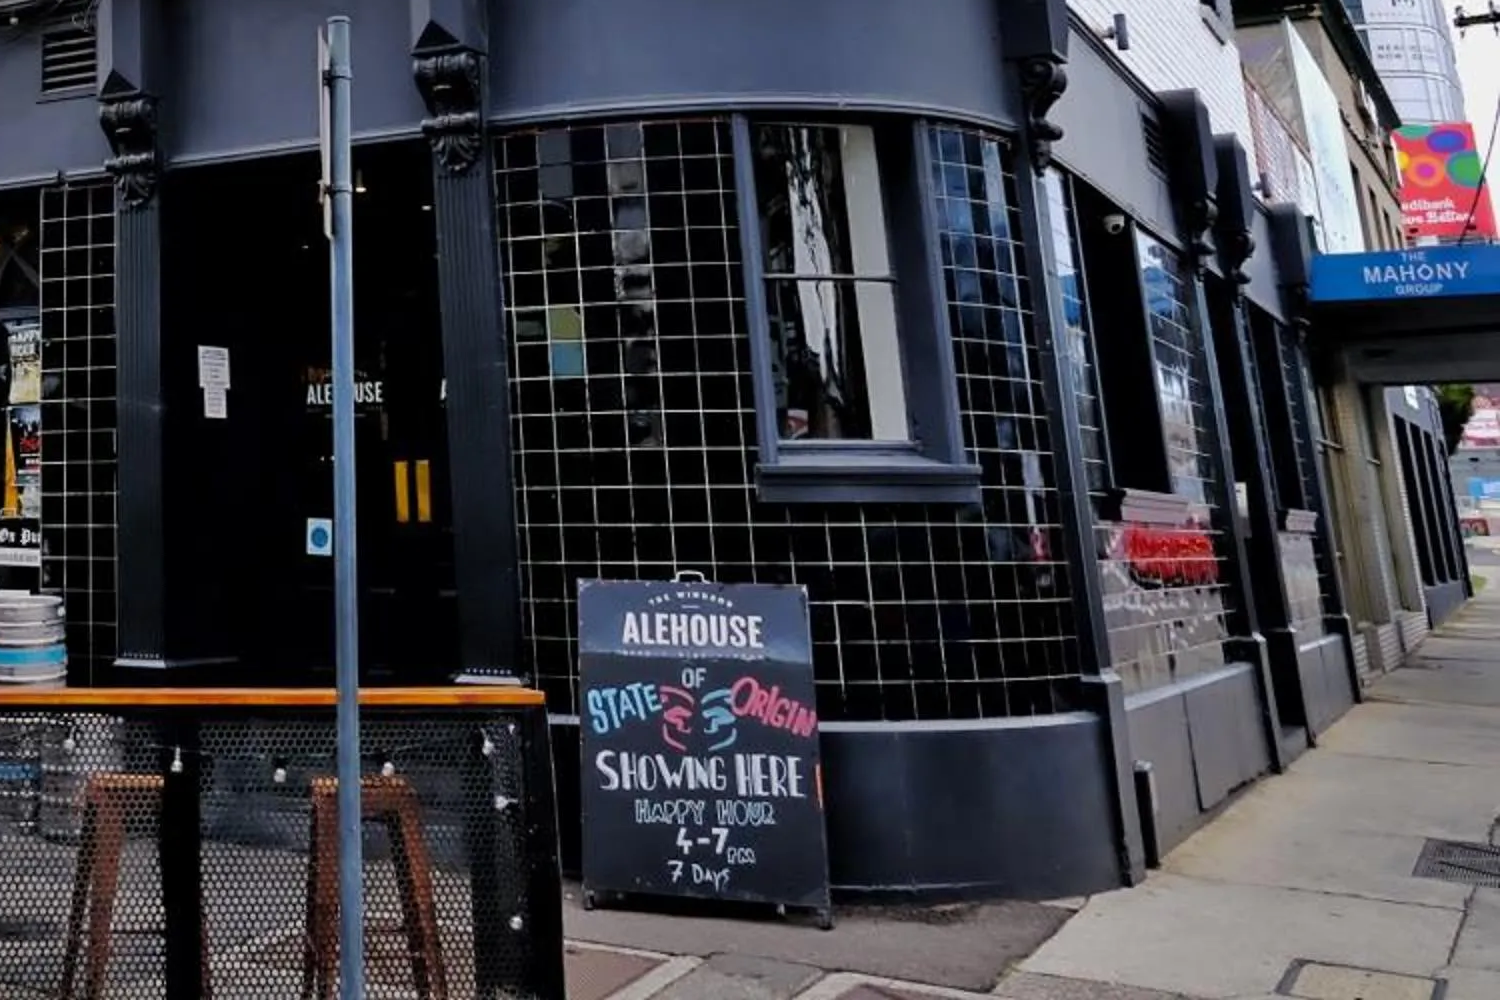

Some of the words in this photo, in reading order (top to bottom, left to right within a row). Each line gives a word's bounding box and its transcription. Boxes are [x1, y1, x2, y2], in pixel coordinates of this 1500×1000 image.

[1401, 251, 1426, 262] THE
[1363, 262, 1469, 284] MAHONY
[1395, 283, 1443, 296] GROUP
[306, 381, 383, 405] ALEUSE
[622, 611, 764, 649] ALEHOUSE
[587, 682, 662, 734] STATE
[681, 667, 706, 689] OF
[730, 676, 818, 738] ORIGIN
[596, 750, 727, 792] SHOWING
[736, 753, 806, 798] HERE
[635, 798, 706, 825] HAPPY
[715, 799, 777, 827] HOUR
[667, 859, 684, 884] 7
